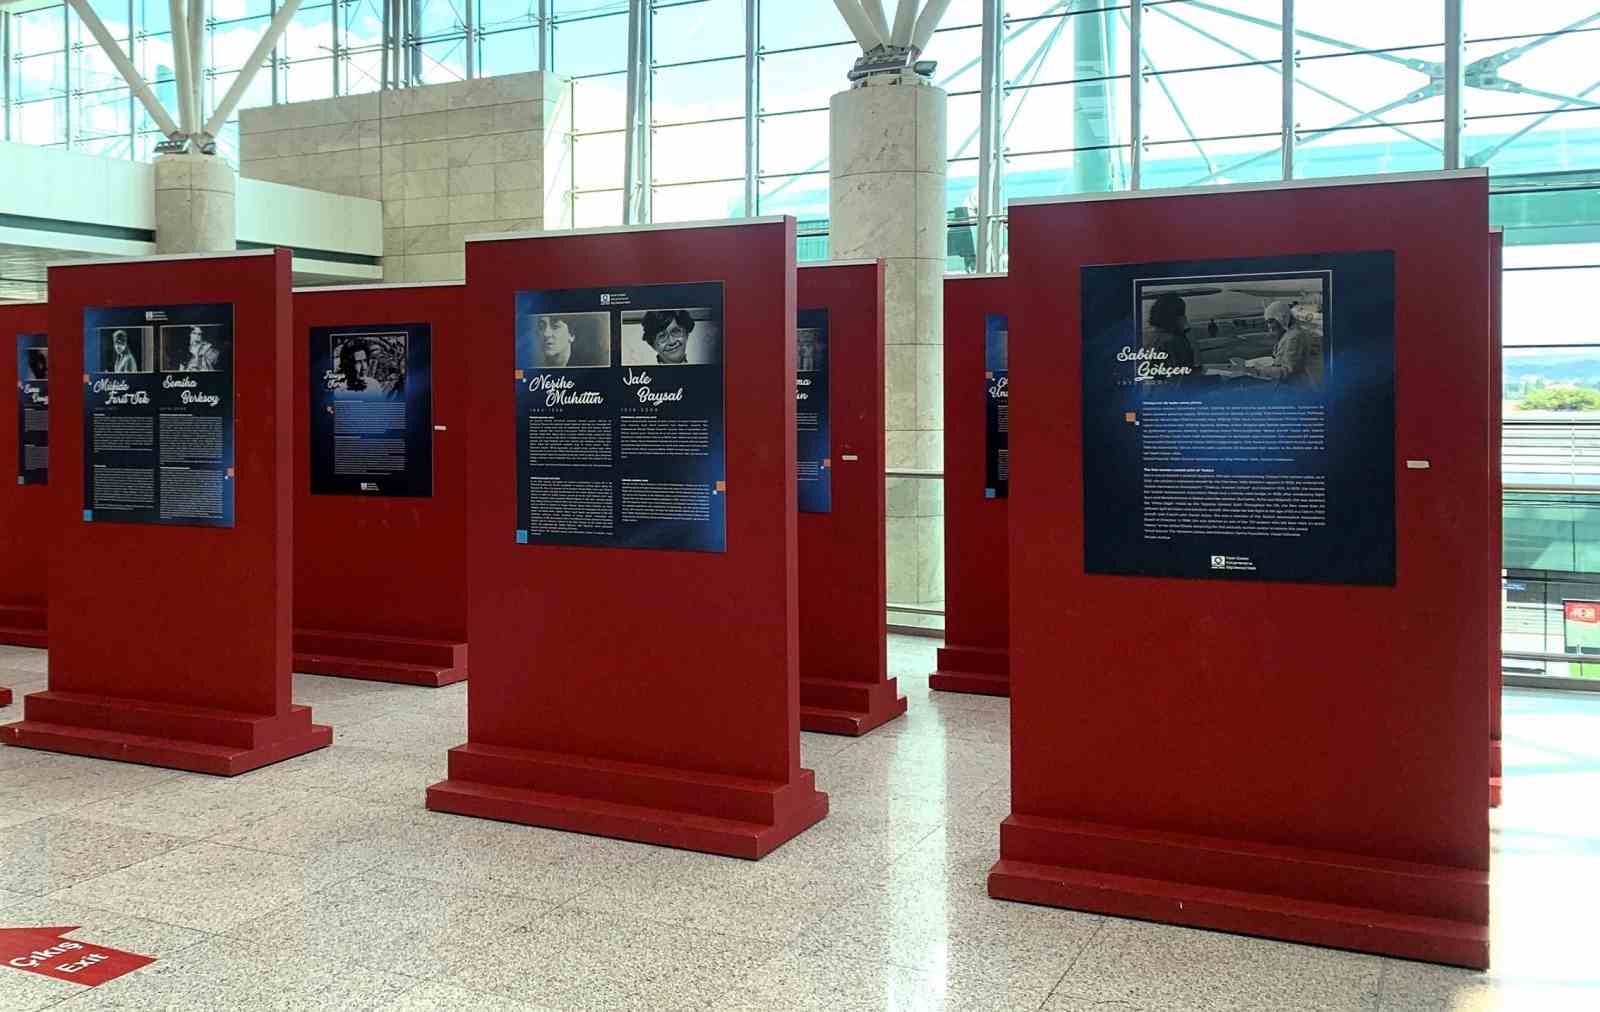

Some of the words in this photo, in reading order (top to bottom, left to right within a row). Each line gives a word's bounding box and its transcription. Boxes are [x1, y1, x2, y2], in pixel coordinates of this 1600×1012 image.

[1116, 346, 1169, 362] Sabiha
[622, 368, 652, 386] Jale
[1134, 361, 1193, 382] Gökçen
[528, 374, 576, 392] Nezihe
[545, 389, 605, 407] Muhittin
[636, 386, 684, 406] Baysal
[9, 942, 84, 968] Çıkış
[54, 953, 110, 973] Exit
